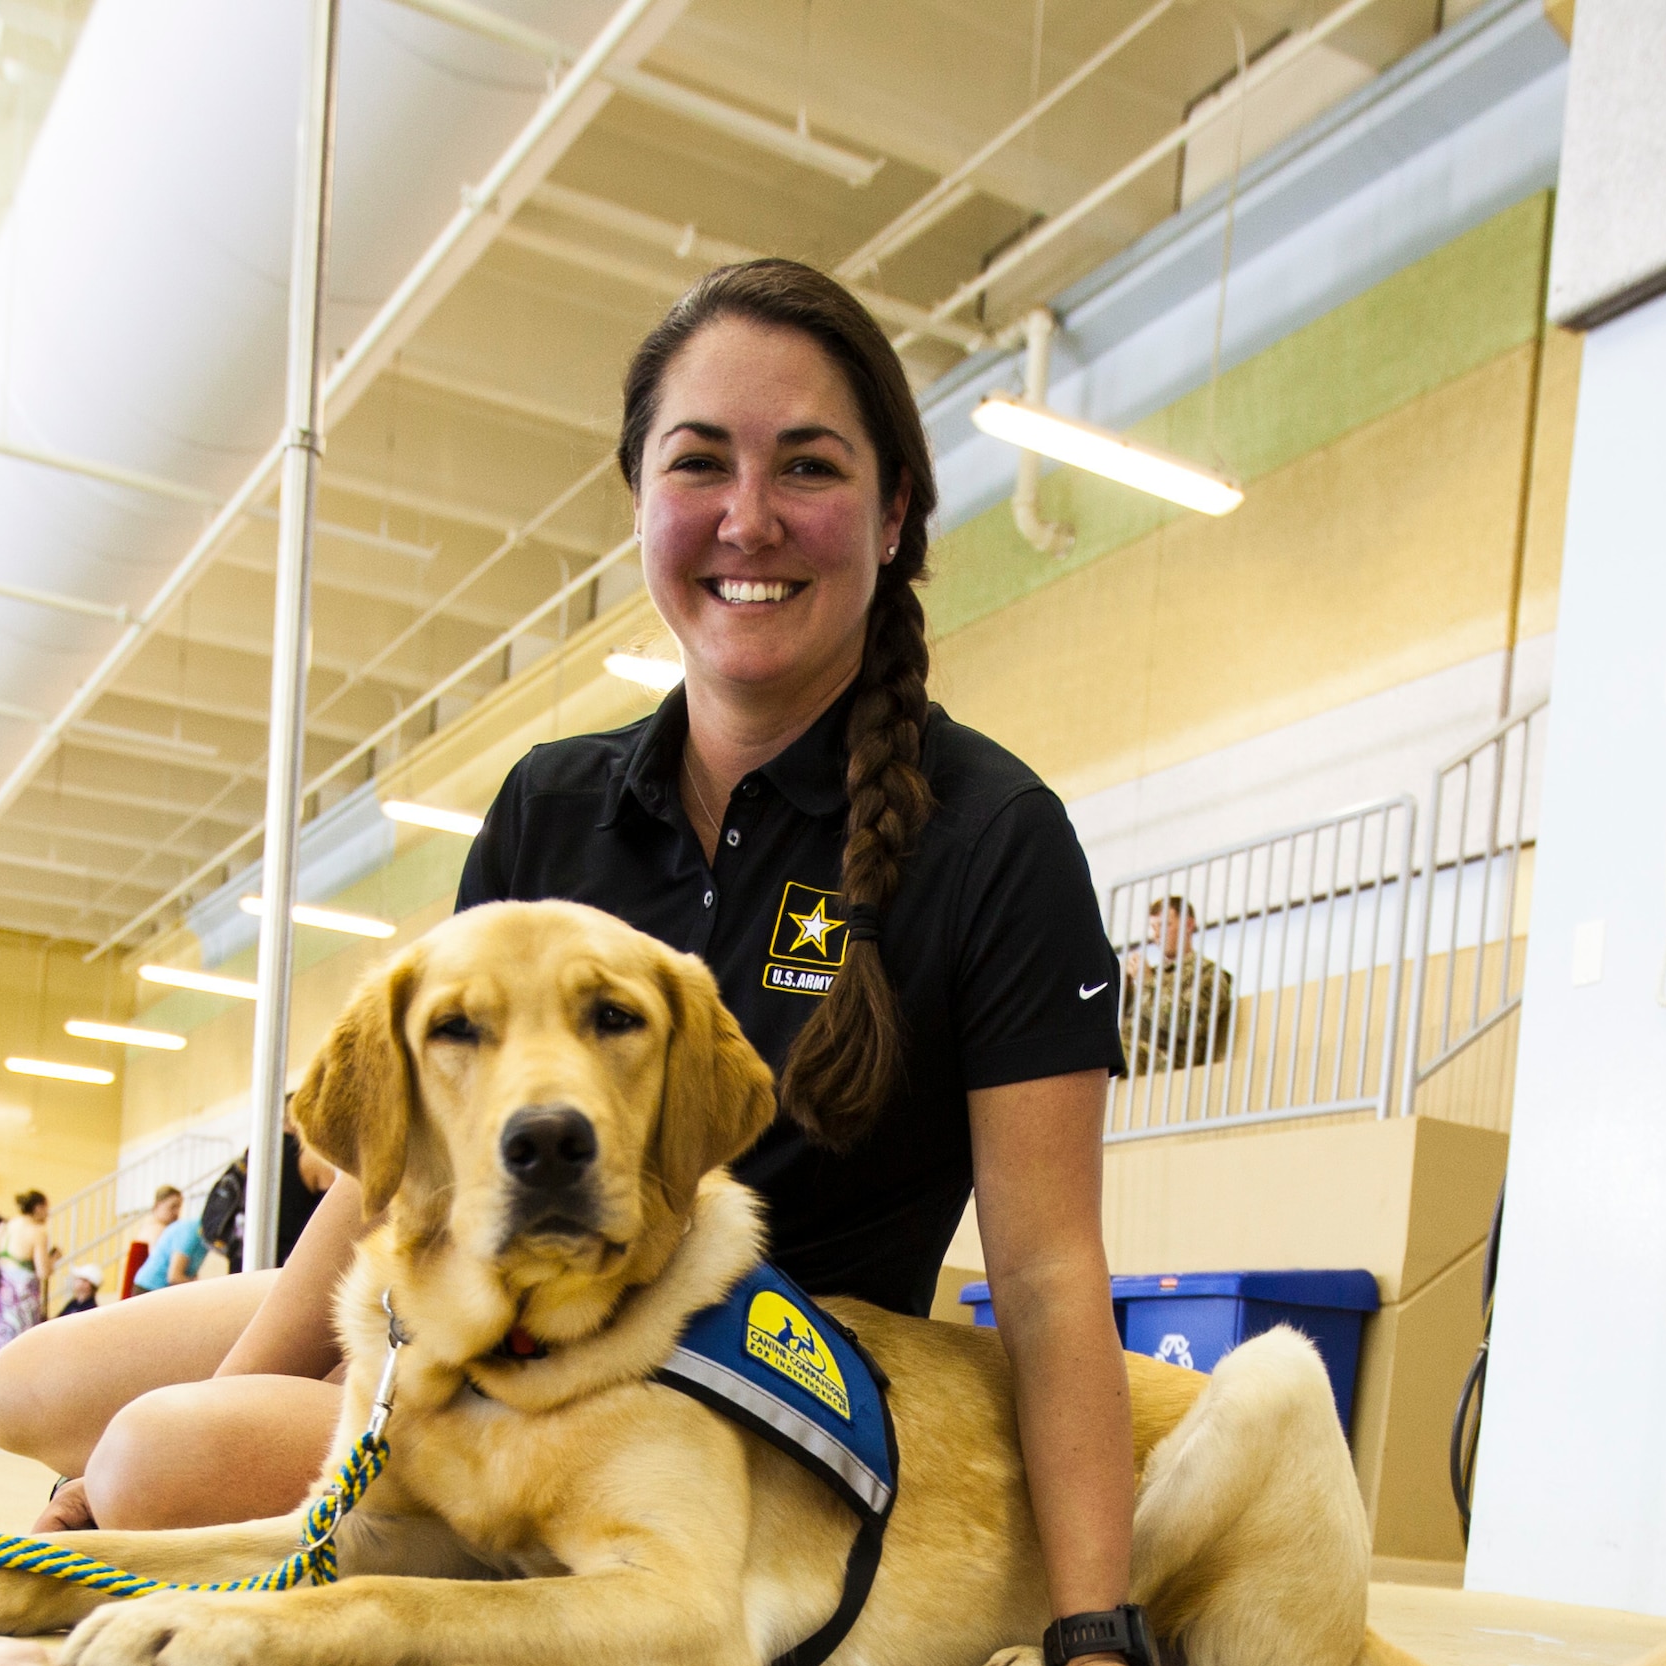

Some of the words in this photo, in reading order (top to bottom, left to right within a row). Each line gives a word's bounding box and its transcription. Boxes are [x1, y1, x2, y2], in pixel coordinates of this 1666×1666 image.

[750, 1331, 787, 1359] CANINE
[790, 1355, 847, 1404] COMPANIONS
[750, 1343, 769, 1358] FOR
[775, 1358, 847, 1412] INDEPENDENCE
